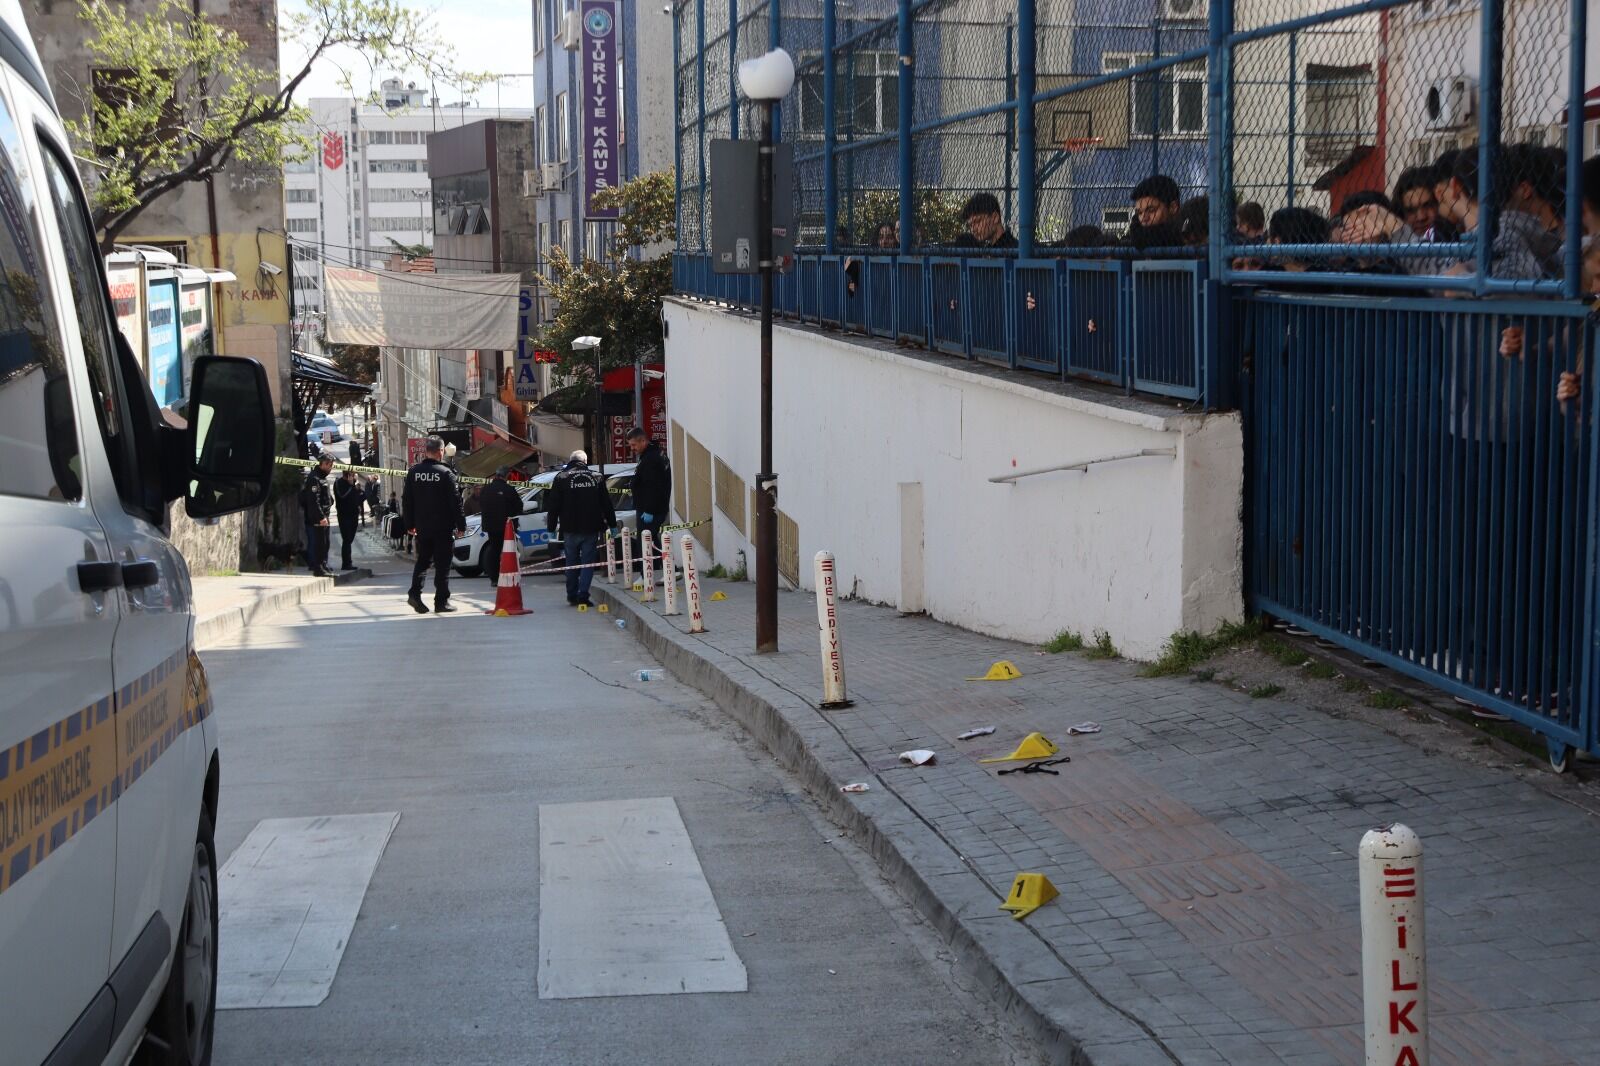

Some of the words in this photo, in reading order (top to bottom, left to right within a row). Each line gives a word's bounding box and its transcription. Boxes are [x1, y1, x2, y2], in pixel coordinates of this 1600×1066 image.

[592, 126, 609, 210] KAMU-S
[516, 386, 538, 397] Giyim
[613, 415, 624, 464] GÖZL
[414, 472, 441, 482] POLİS
[687, 553, 702, 621] İLKADIM
[824, 576, 840, 683] BELEDİYESİ
[1004, 665, 1013, 676] 2
[51, 744, 92, 814] İNCELEME
[1015, 879, 1025, 898] 1
